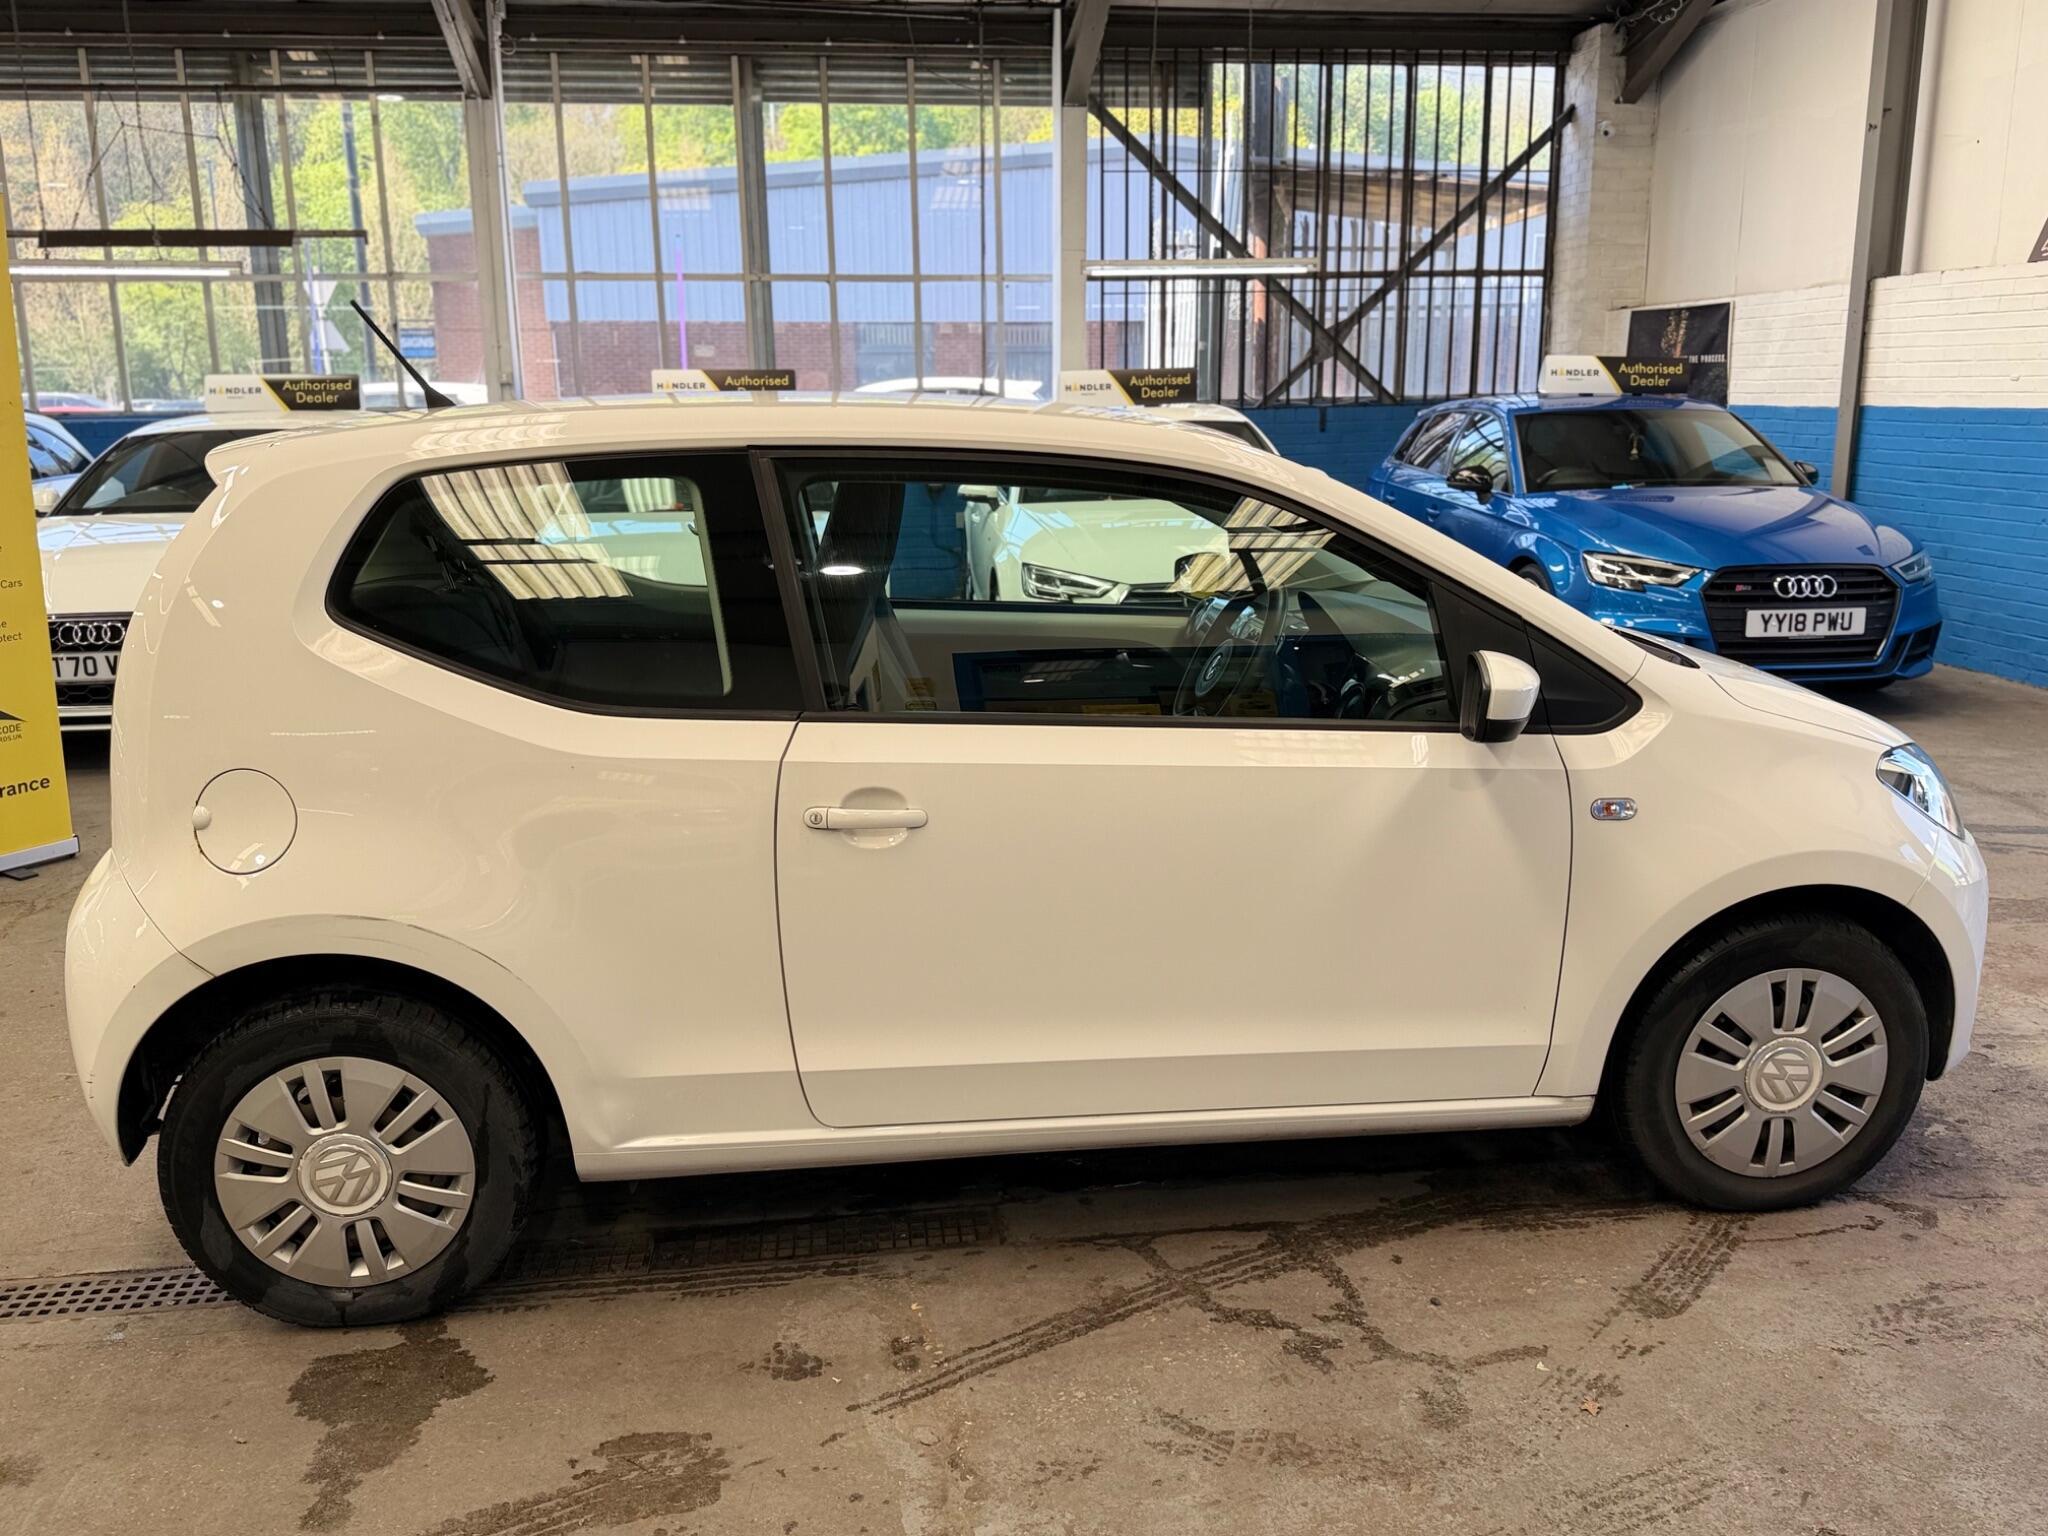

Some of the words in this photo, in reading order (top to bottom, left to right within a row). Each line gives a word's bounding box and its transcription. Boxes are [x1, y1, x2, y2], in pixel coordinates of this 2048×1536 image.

[1618, 363, 1683, 374] Authorised
[282, 380, 352, 391] Authorised
[725, 375, 790, 386] Authorised
[1129, 373, 1191, 386] Authorised
[1630, 375, 1671, 387] Dealer
[296, 392, 340, 404] Dealer
[1141, 386, 1180, 398] Dealer
[0, 580, 23, 588] Cars
[1761, 612, 1807, 633] YY18
[1813, 611, 1853, 632] PWU
[0, 723, 22, 735] ODE
